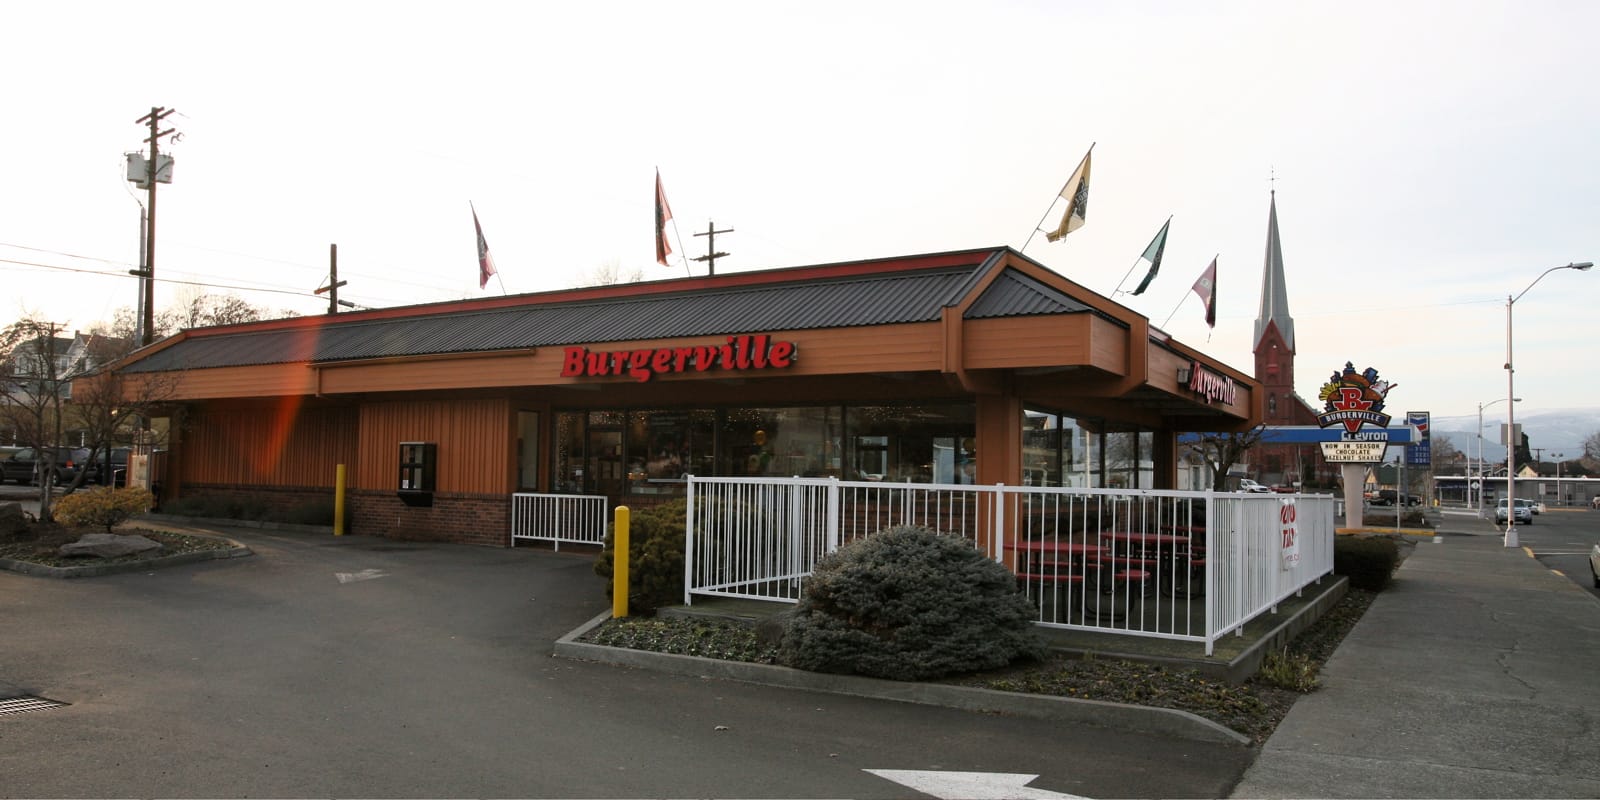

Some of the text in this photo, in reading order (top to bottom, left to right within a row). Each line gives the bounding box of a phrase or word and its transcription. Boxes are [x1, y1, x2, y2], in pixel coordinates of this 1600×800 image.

[560, 334, 795, 383] Burgerville
[1190, 361, 1236, 406] Burgerville
[1325, 411, 1381, 422] BURGERVILLE
